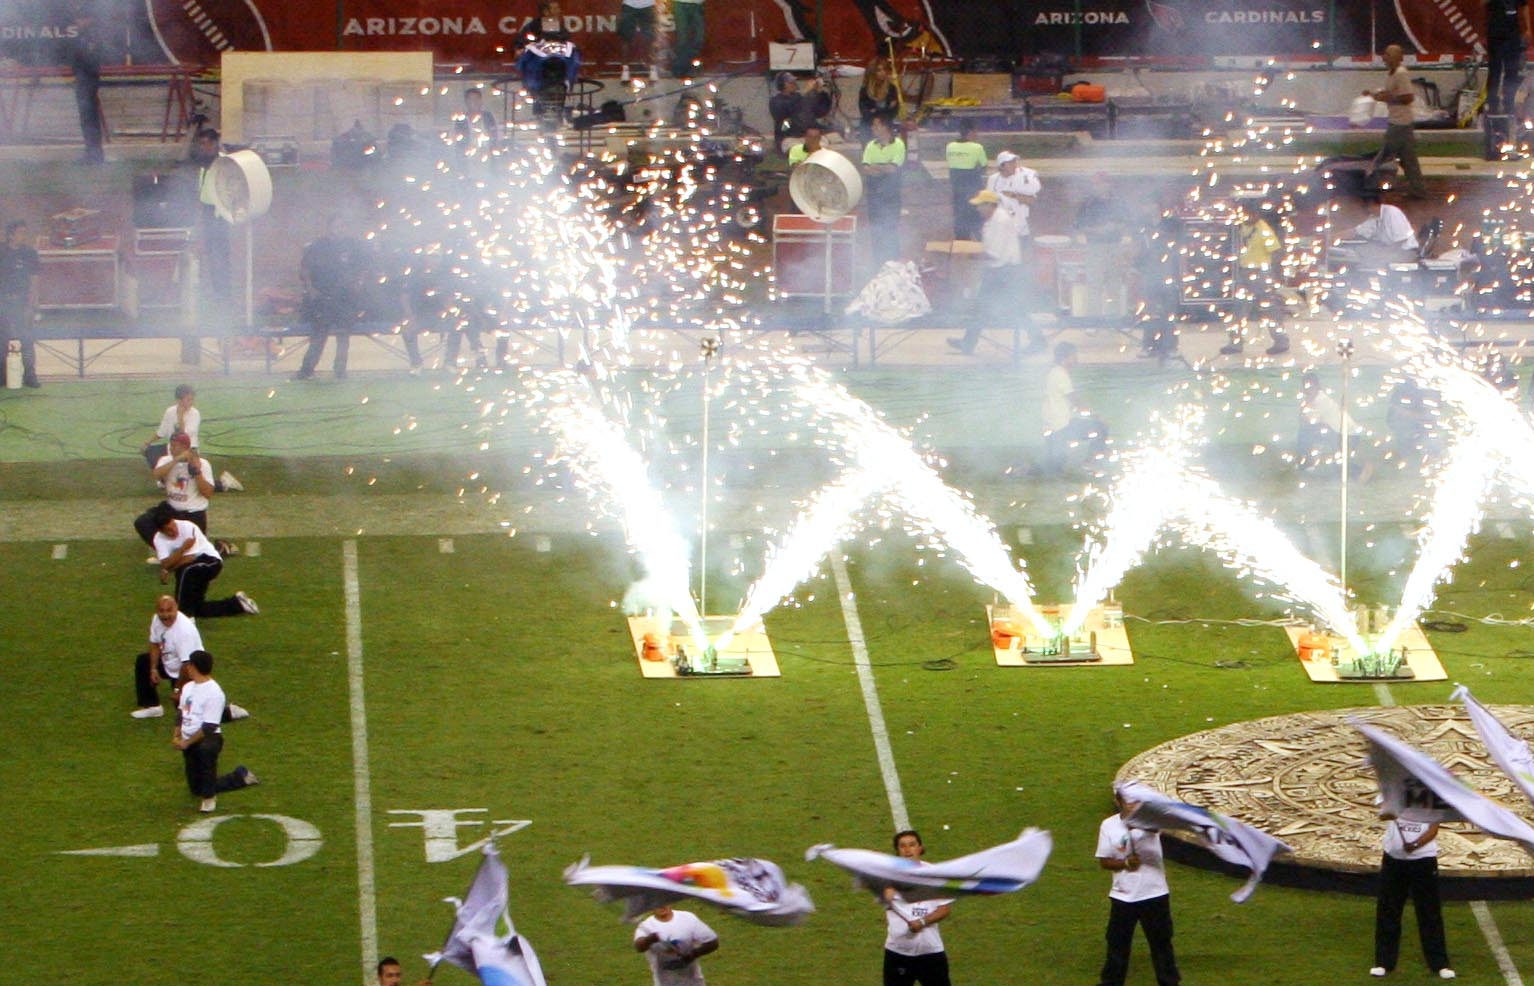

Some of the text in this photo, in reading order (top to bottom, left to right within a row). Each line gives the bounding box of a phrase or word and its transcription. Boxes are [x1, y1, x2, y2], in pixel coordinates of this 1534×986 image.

[1204, 11, 1324, 23] CARDINALS
[343, 17, 487, 35] ARIZONA
[786, 48, 798, 64] 7
